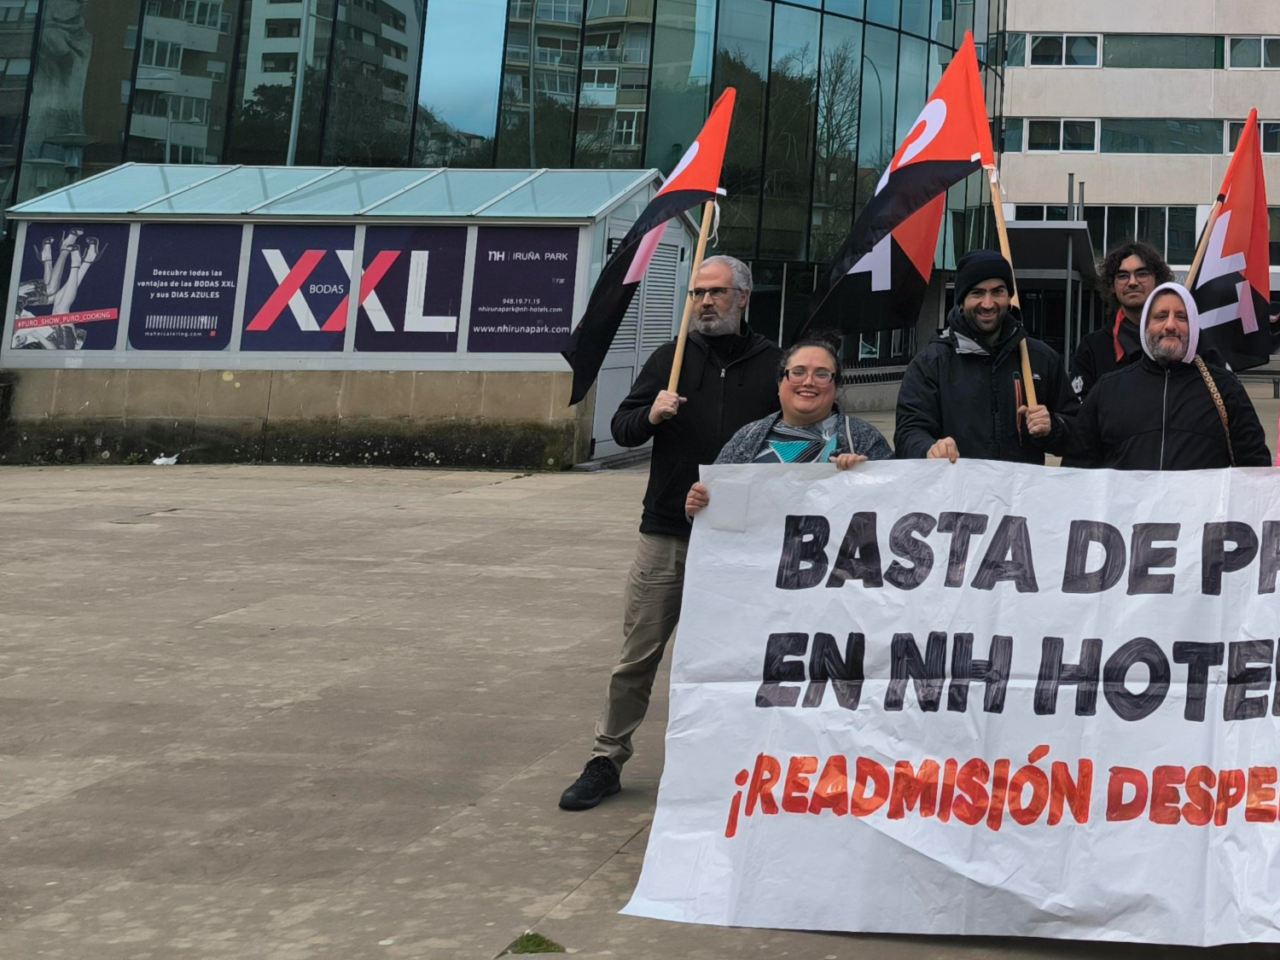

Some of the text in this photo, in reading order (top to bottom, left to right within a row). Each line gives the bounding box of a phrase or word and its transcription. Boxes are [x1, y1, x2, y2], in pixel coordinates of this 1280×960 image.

[512, 251, 540, 261] IRUÑA
[544, 252, 569, 261] PARK
[137, 280, 168, 288] ventajas
[194, 280, 219, 288] BODAS
[220, 280, 236, 288] XXL
[245, 249, 457, 332] XXL
[309, 284, 344, 294] BODAS
[473, 324, 570, 334] www.nhirunapark.com
[776, 512, 1038, 593] BASTA
[1062, 520, 1181, 596] DE
[755, 632, 865, 710] EN
[884, 631, 1013, 714] NH
[725, 744, 1093, 838] ¡READMISIÓN
